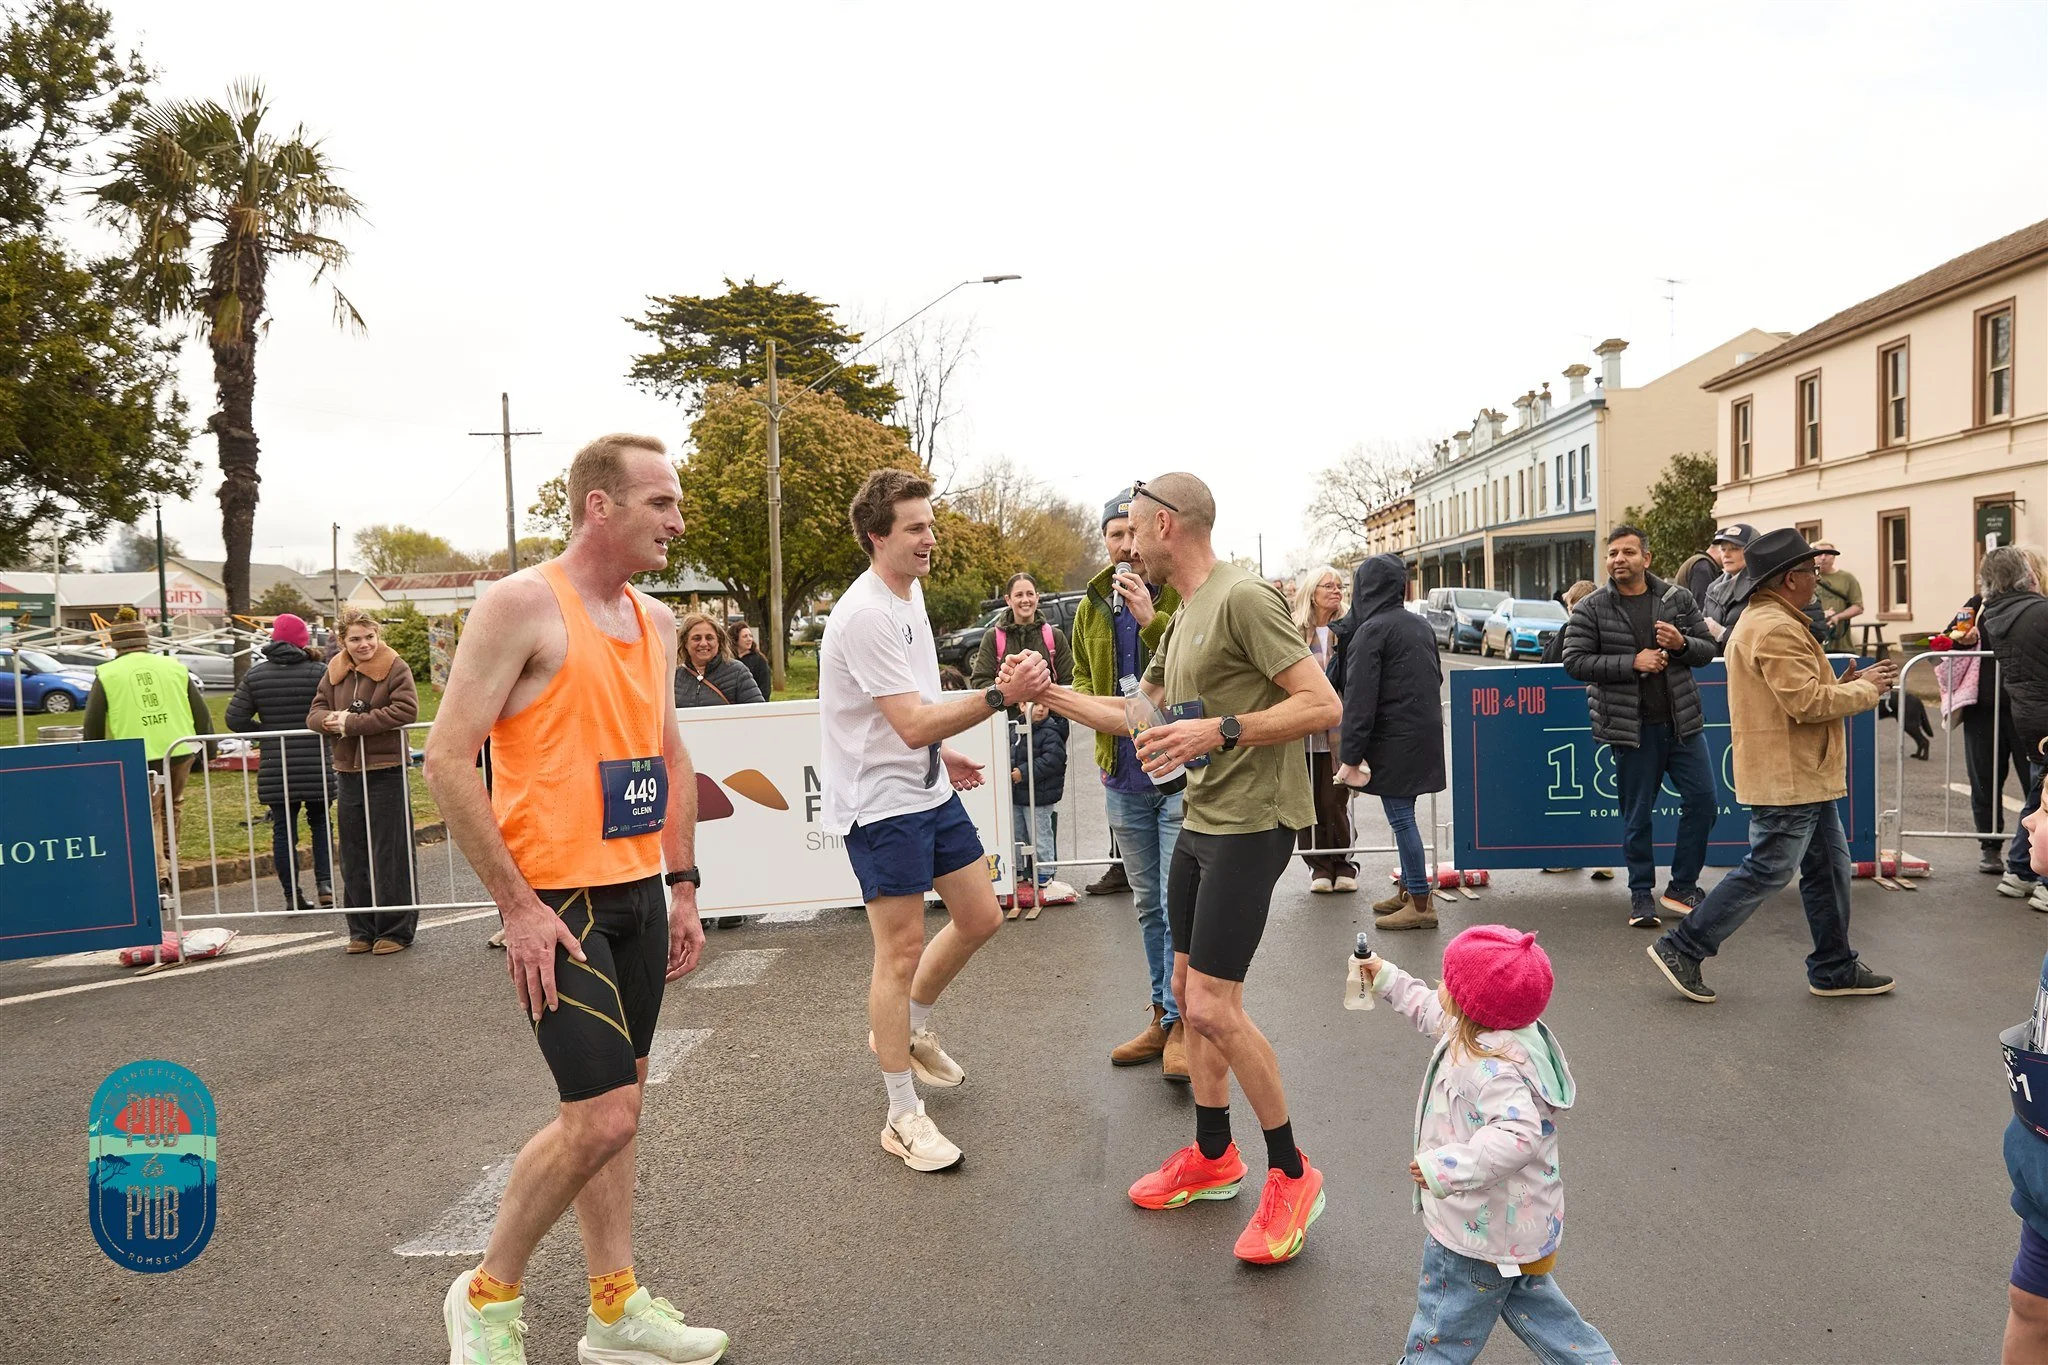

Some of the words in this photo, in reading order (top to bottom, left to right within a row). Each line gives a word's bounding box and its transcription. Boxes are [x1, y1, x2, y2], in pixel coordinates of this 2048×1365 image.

[164, 590, 202, 604] GIFTS
[136, 672, 153, 686] PUB
[142, 693, 159, 708] PUB
[1472, 688, 1500, 716] PUB
[1503, 694, 1516, 708] to
[1518, 686, 1546, 715] PUB
[141, 713, 168, 727] STAFF
[624, 777, 657, 804] 449
[632, 806, 653, 816] GLENN
